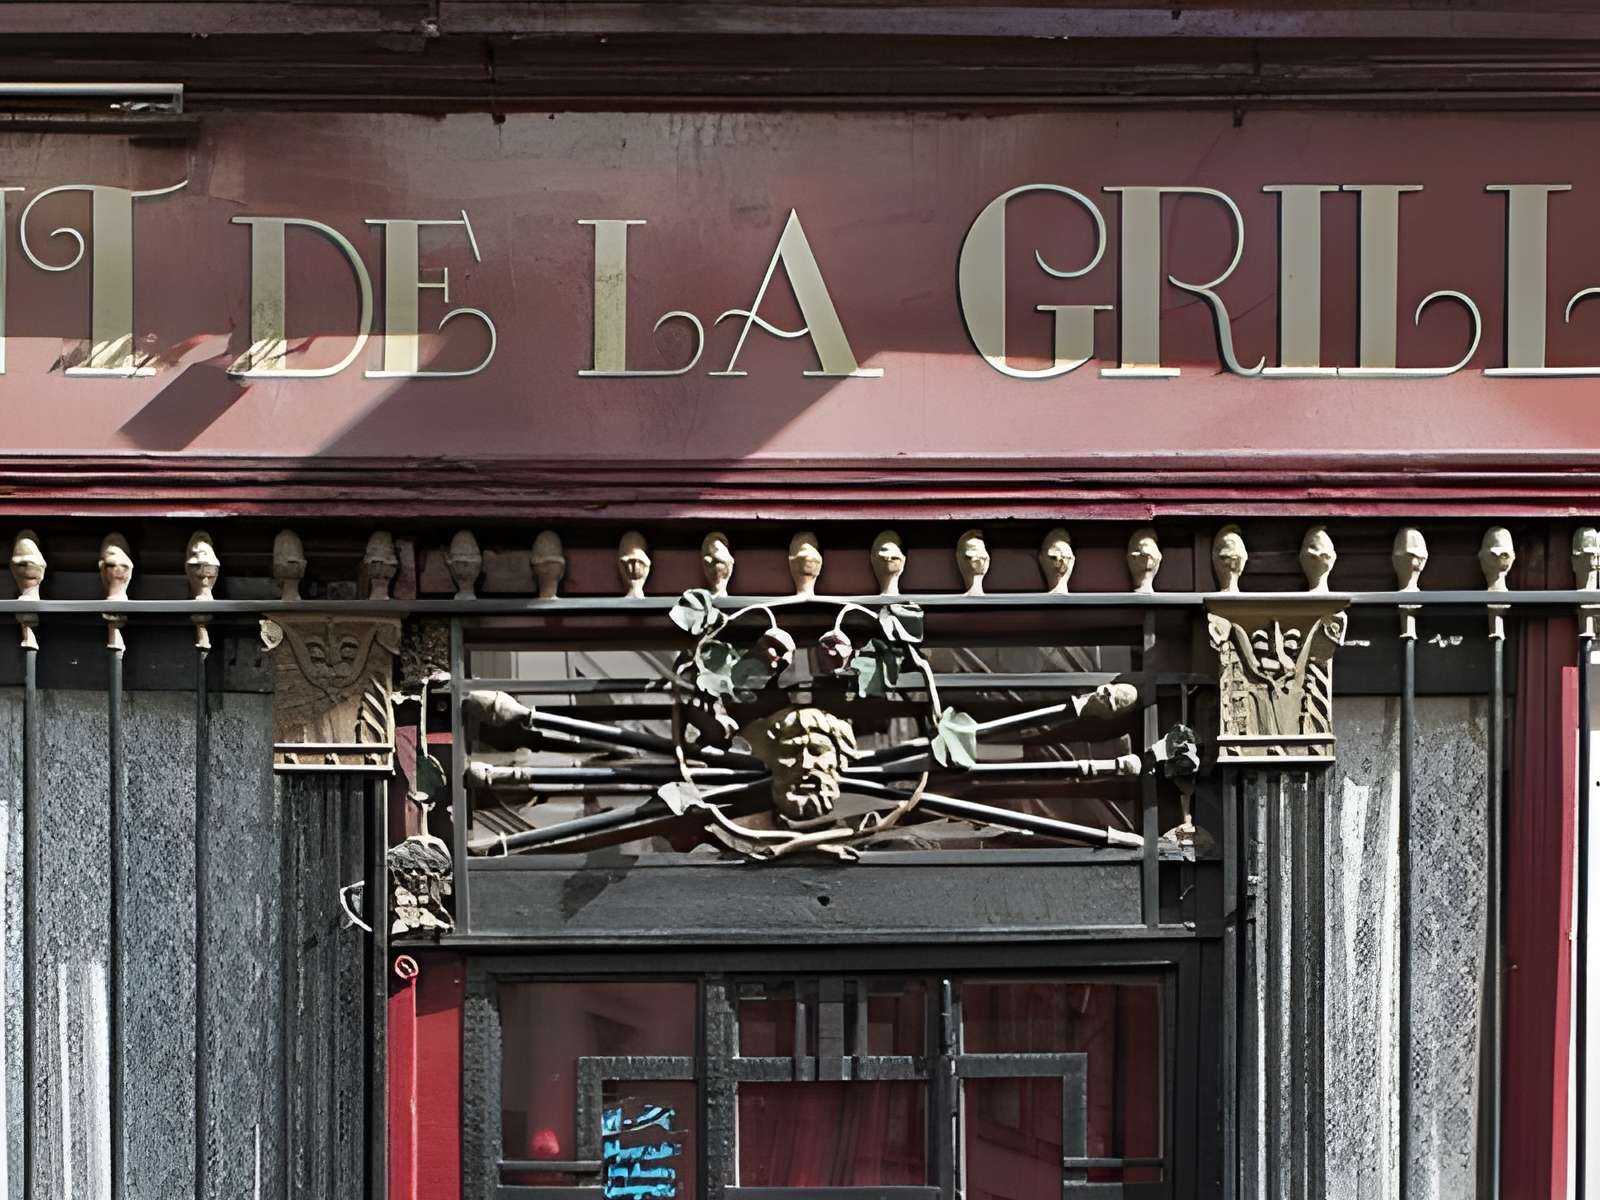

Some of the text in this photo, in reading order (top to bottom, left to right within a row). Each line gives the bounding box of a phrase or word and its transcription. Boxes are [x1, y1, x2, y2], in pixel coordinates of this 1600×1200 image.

[0, 178, 188, 378] T
[228, 209, 498, 379] DE
[576, 205, 885, 378] LA
